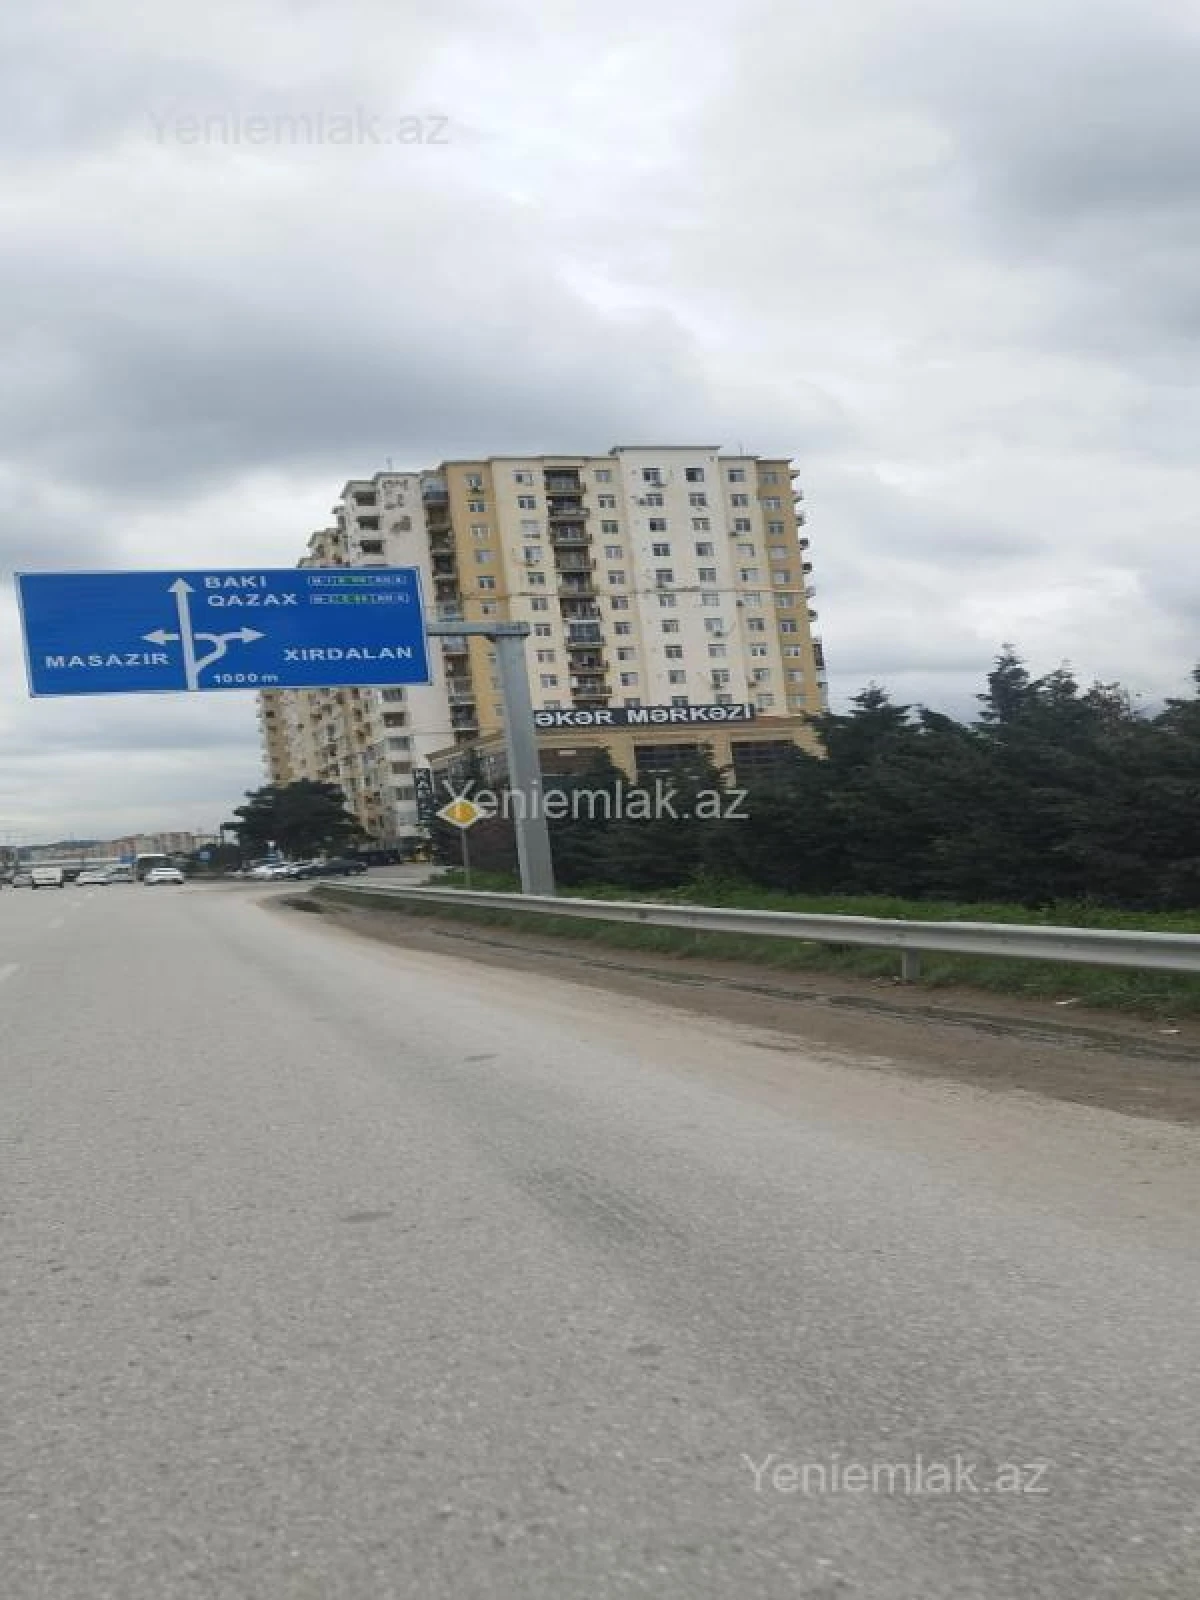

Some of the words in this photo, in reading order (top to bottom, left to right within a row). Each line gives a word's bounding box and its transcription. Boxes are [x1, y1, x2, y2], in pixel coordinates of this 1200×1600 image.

[204, 576, 267, 588] BAKI
[207, 593, 298, 607] QAZAX
[45, 652, 169, 669] MASAZIR
[283, 647, 413, 661] XIRDALAN
[212, 673, 259, 683] 1000
[261, 673, 279, 682] m
[535, 710, 614, 726] ƏKƏR
